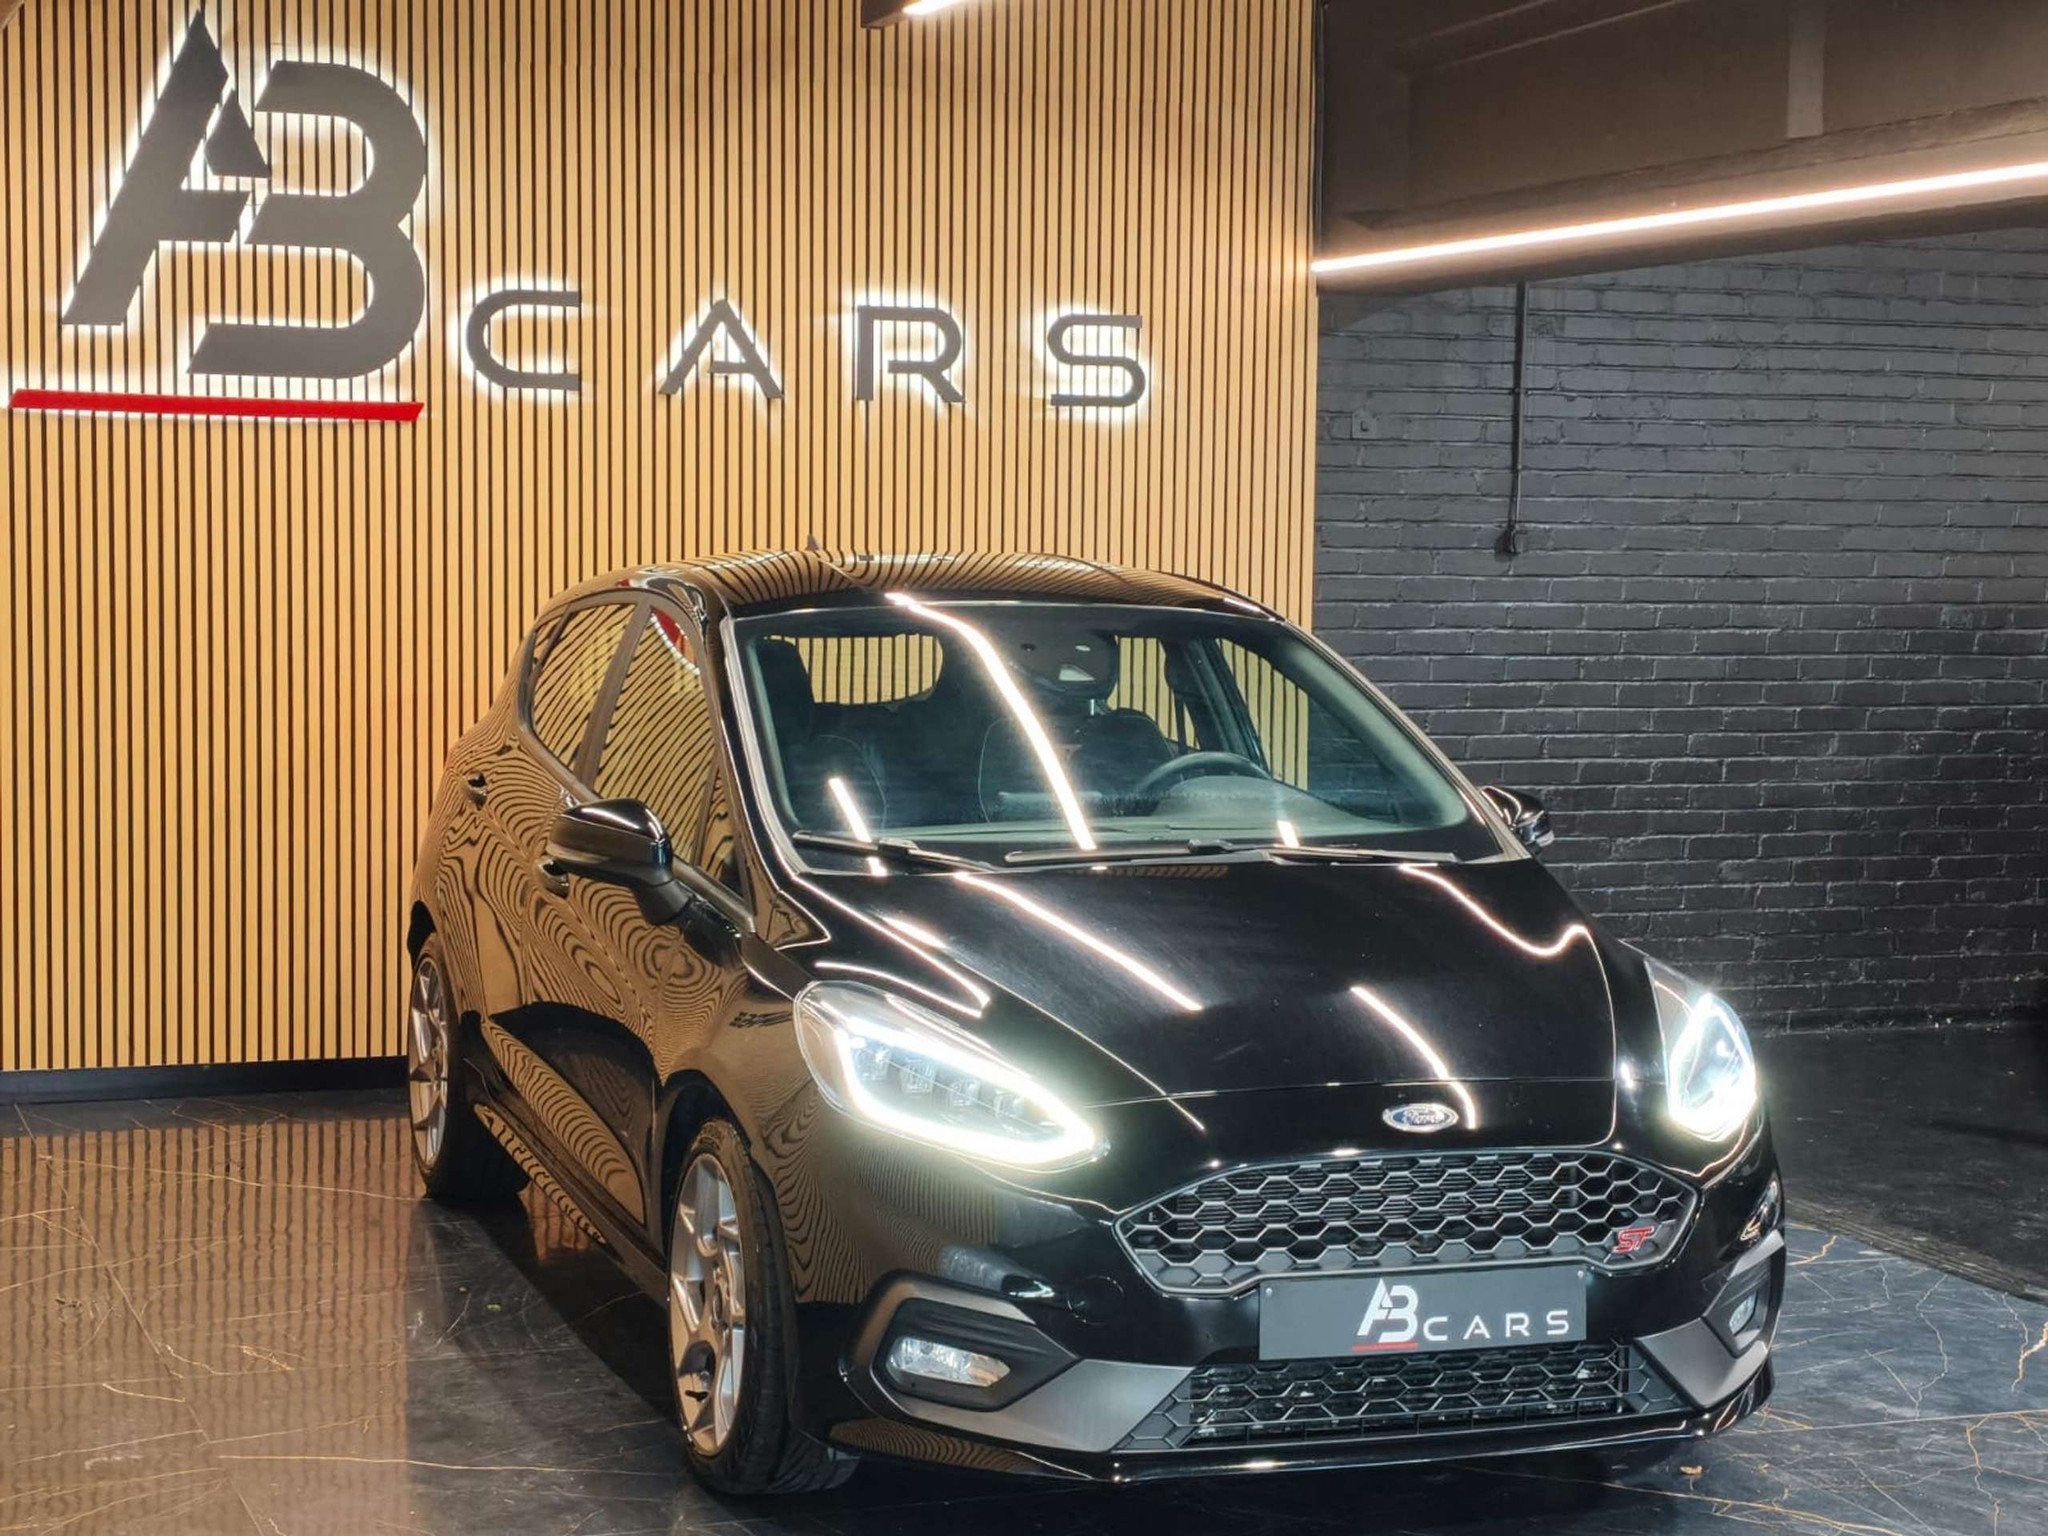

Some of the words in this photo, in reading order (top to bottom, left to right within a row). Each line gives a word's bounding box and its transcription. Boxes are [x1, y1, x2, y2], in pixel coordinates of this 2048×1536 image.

[62, 9, 426, 379] AB
[466, 289, 1148, 407] CARS
[1612, 1226, 1655, 1253] ST
[1357, 1278, 1419, 1343] AB
[1423, 1310, 1570, 1341] CARS
